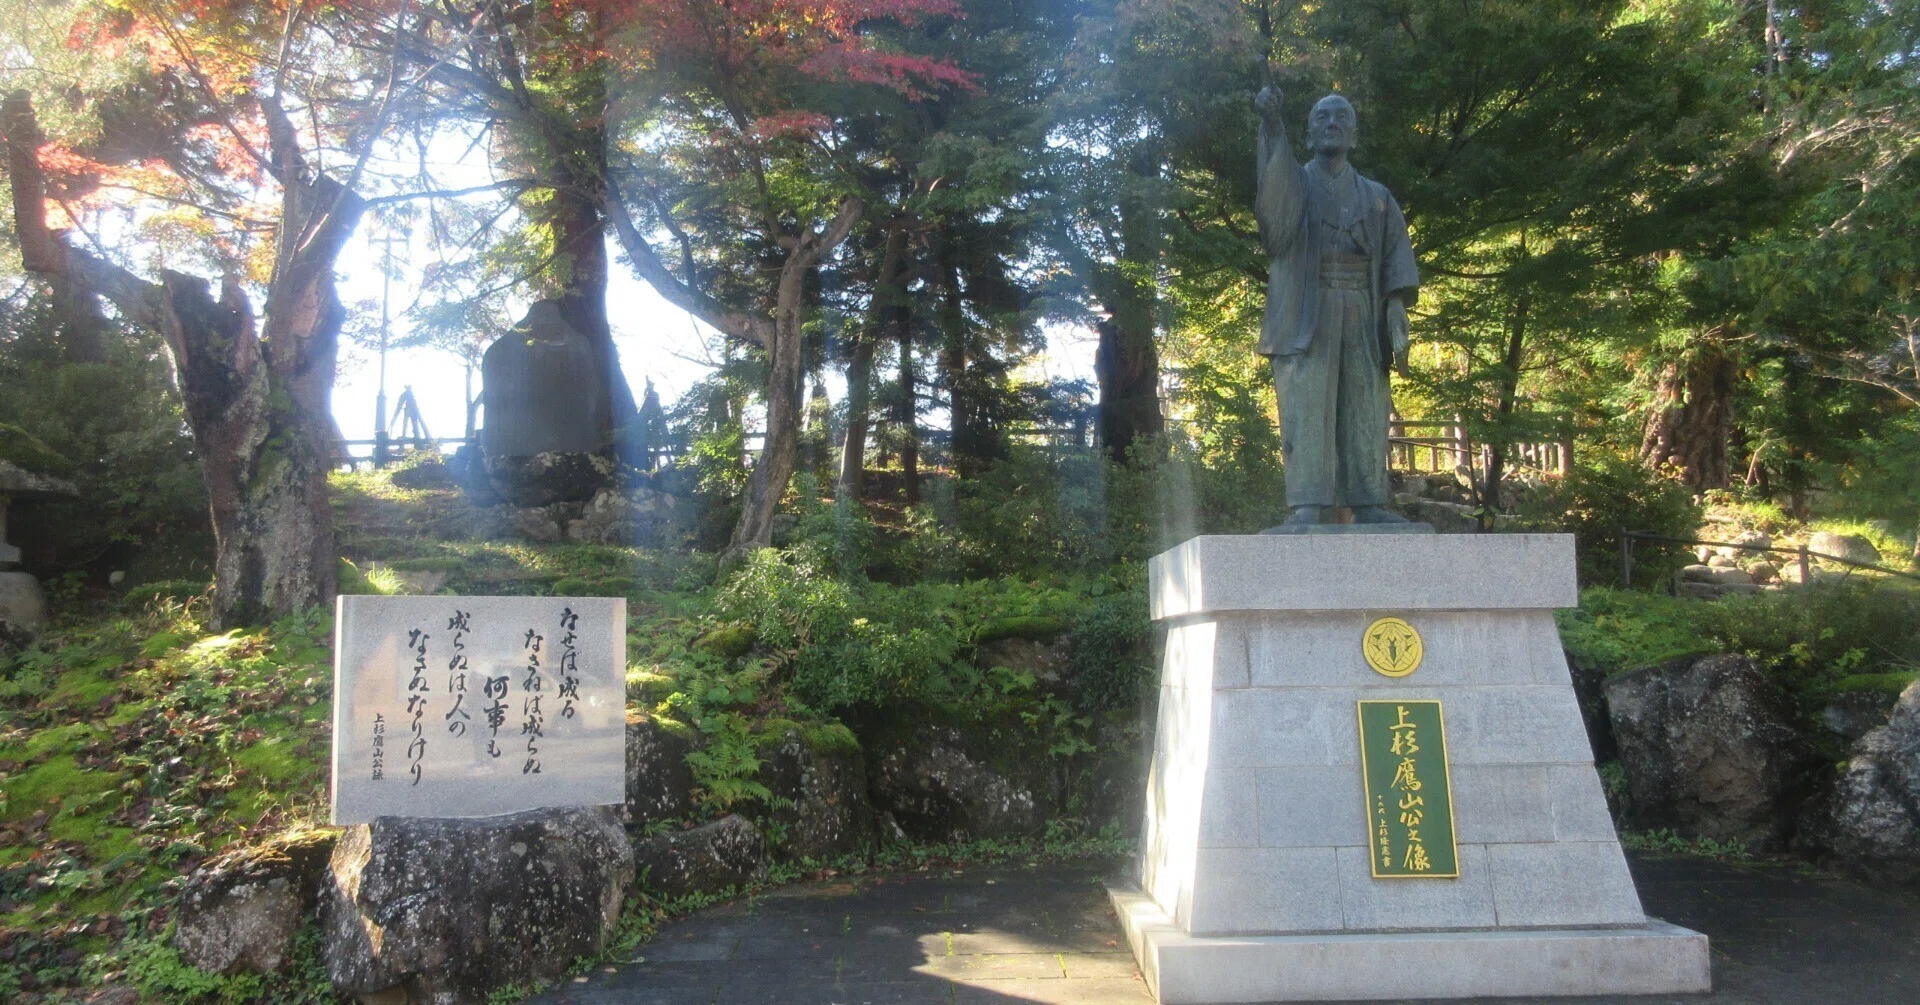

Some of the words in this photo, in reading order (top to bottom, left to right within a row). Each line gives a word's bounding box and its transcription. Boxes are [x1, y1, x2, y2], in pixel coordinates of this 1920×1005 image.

[406, 628, 431, 787] なさぬなりけり
[445, 609, 472, 739] 成らぬは人の
[483, 675, 510, 759] 何事も
[520, 628, 544, 775] なさねば成らぬ
[557, 607, 580, 720] なせば成る
[372, 712, 386, 781] 上杉鷹山公詠
[1388, 705, 1431, 872] 上杉鷹山公之像
